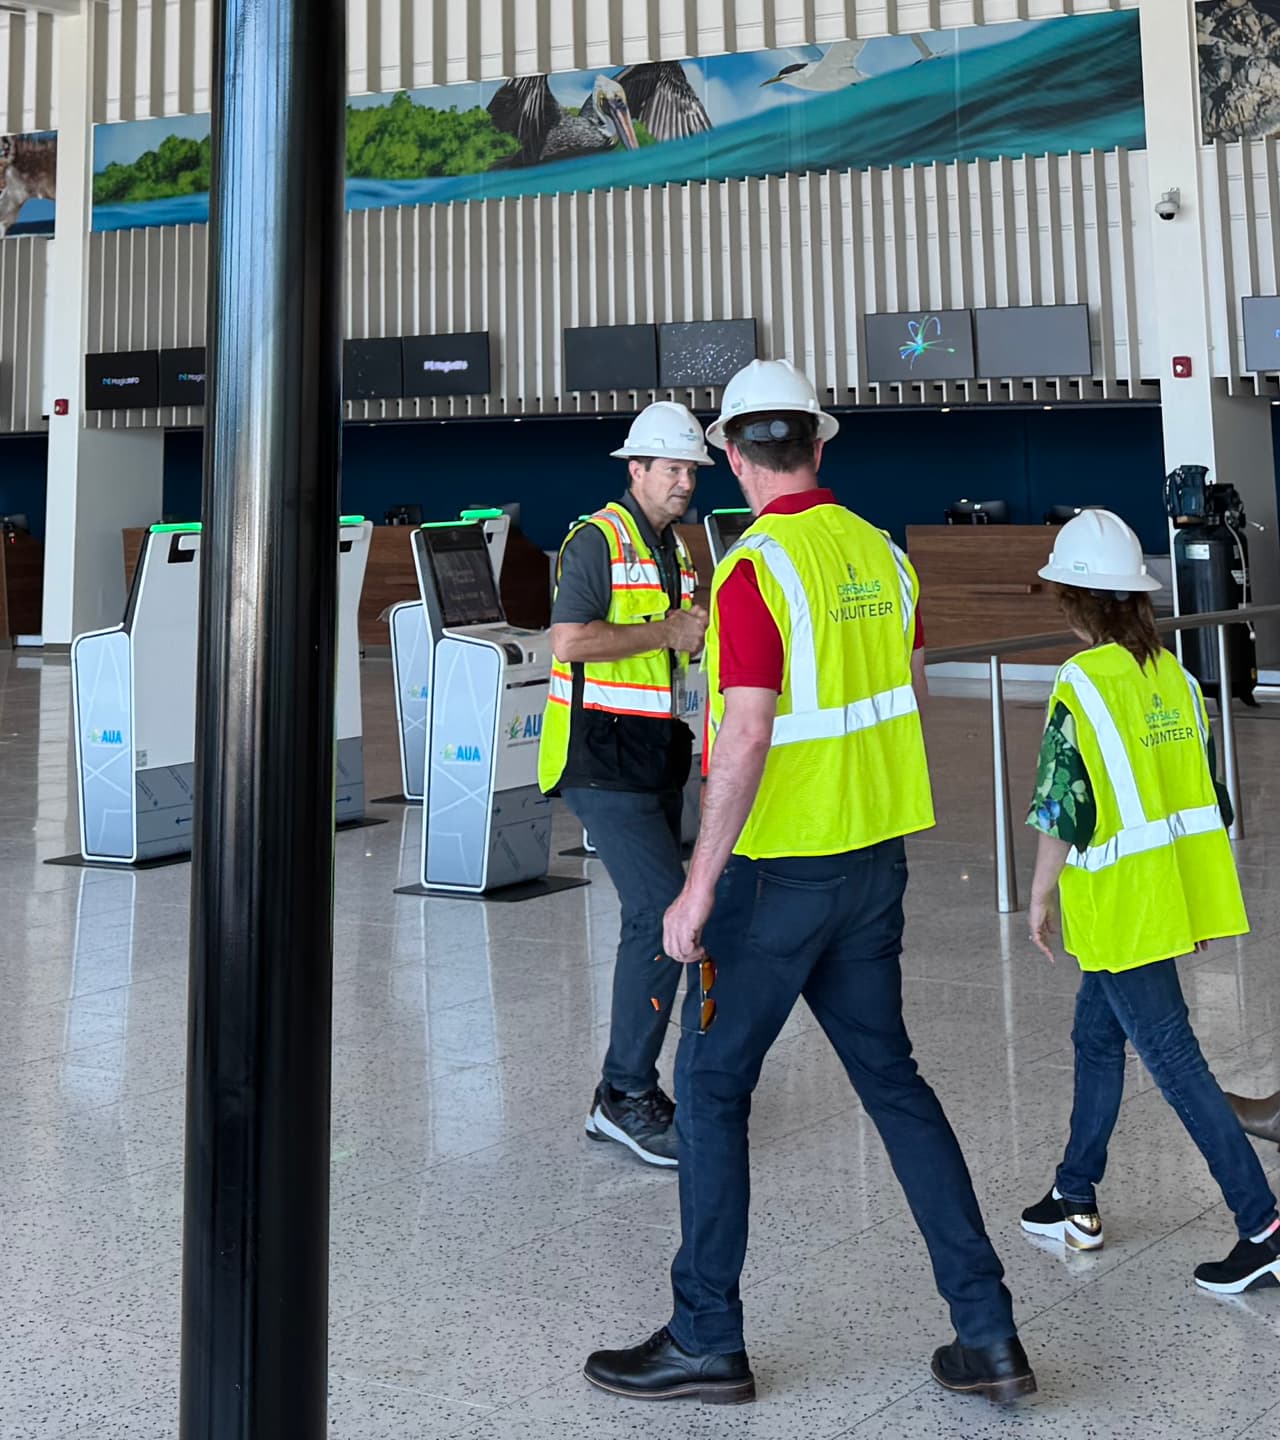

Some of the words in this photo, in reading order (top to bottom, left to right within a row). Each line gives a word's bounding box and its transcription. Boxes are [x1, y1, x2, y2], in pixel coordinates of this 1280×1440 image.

[685, 689, 699, 712] UA
[523, 713, 543, 739] AU
[100, 729, 123, 745] AUA
[455, 744, 481, 762] AUA
